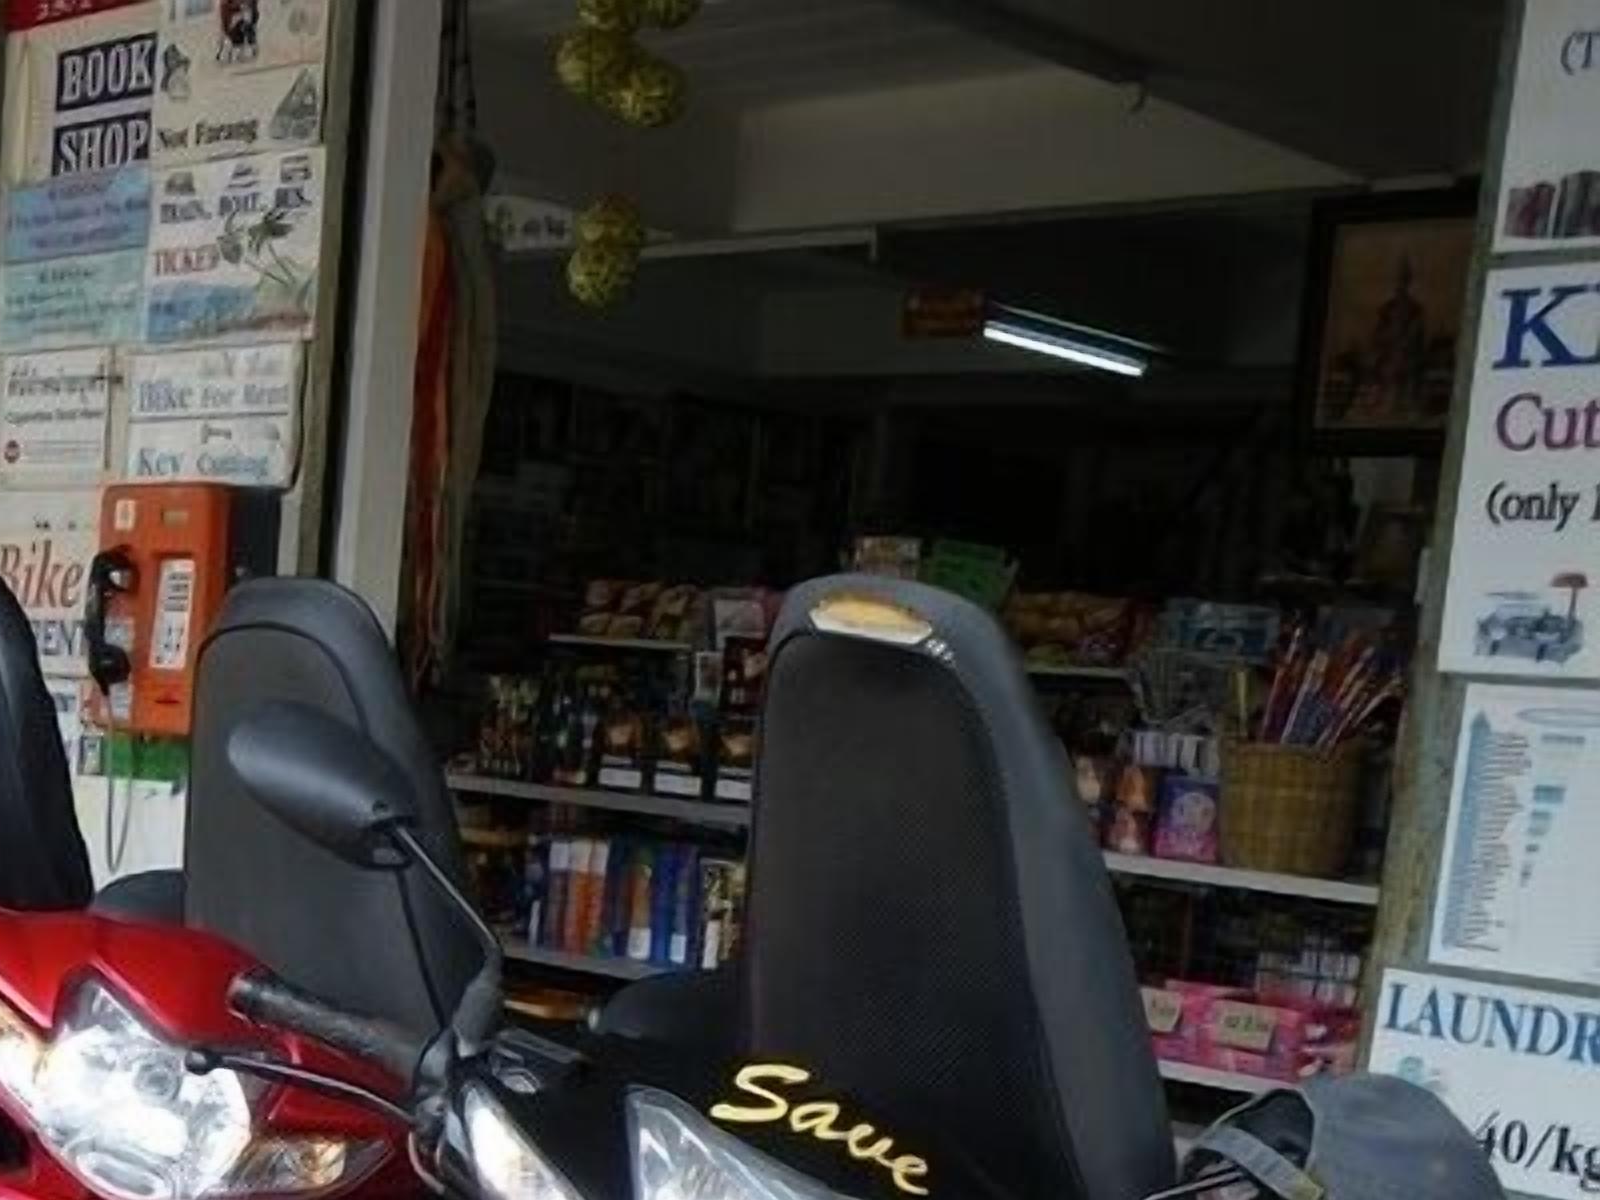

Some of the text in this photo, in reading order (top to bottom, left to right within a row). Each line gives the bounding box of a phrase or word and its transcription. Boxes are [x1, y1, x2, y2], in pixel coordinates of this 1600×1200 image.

[62, 40, 153, 105] BOOK
[59, 119, 148, 176] SHOP
[1492, 282, 1600, 370] K
[1486, 481, 1580, 533] (only
[710, 1063, 929, 1196] Save
